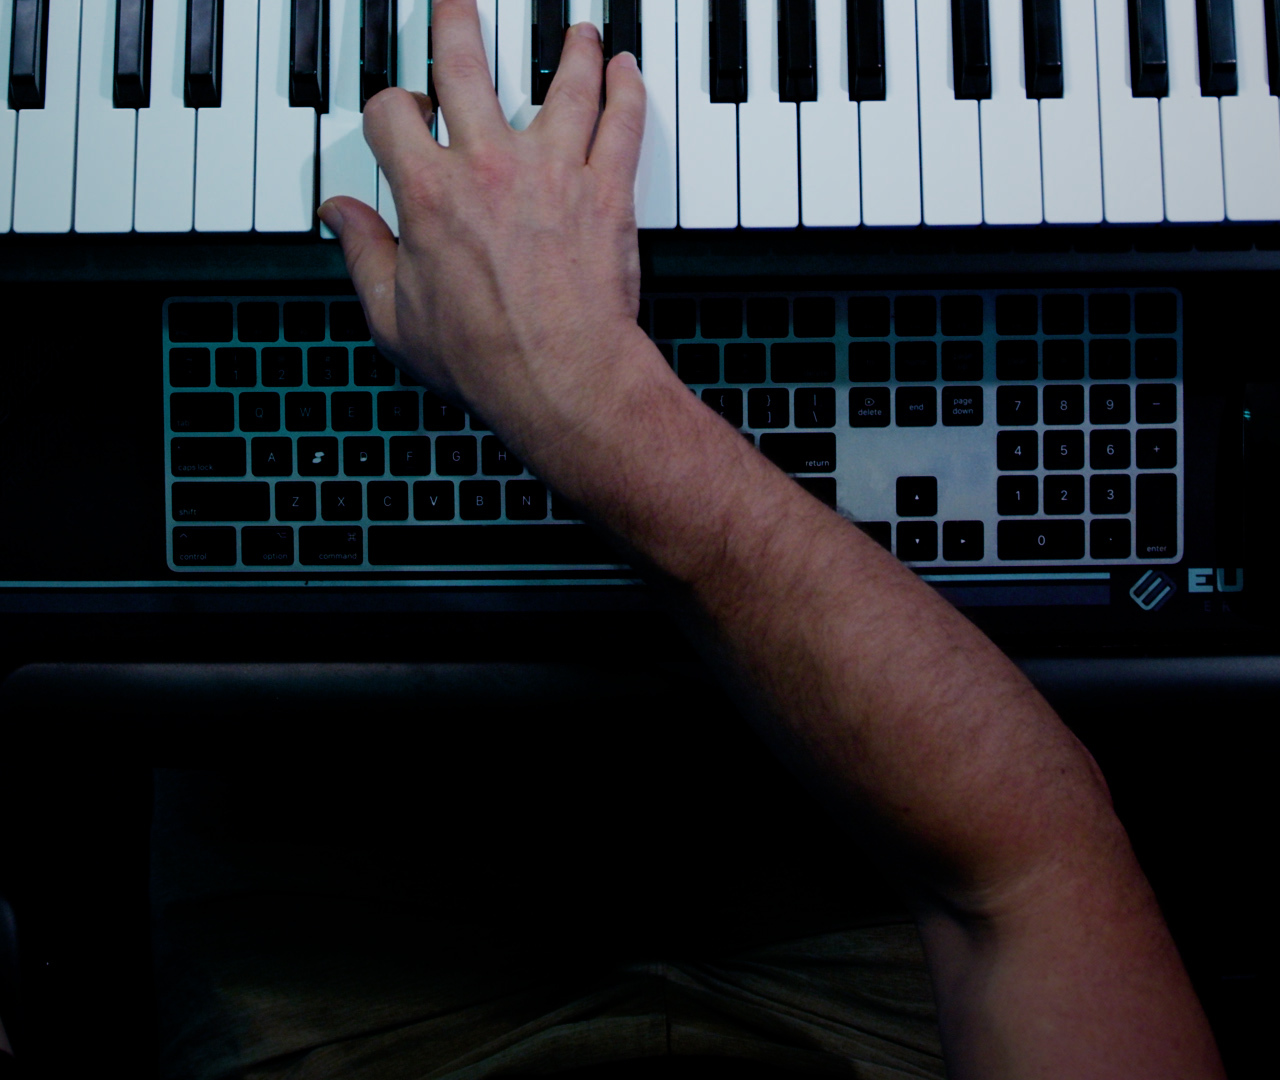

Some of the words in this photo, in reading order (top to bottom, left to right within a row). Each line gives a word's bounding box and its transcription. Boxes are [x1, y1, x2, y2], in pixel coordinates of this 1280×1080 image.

[1014, 401, 1021, 411] 7
[1060, 400, 1067, 410] 8
[1106, 400, 1114, 410] 9
[440, 406, 447, 416] T
[1014, 446, 1021, 455] 4
[1060, 445, 1068, 455] 5
[1106, 445, 1114, 455] 6
[406, 452, 412, 461] F
[452, 451, 461, 462] G
[498, 451, 506, 461] H
[292, 497, 300, 507] Z
[337, 497, 345, 507] X
[383, 496, 392, 507] C
[430, 496, 438, 506] V
[476, 496, 484, 506] B
[522, 496, 530, 506] N
[263, 552, 288, 561] option
